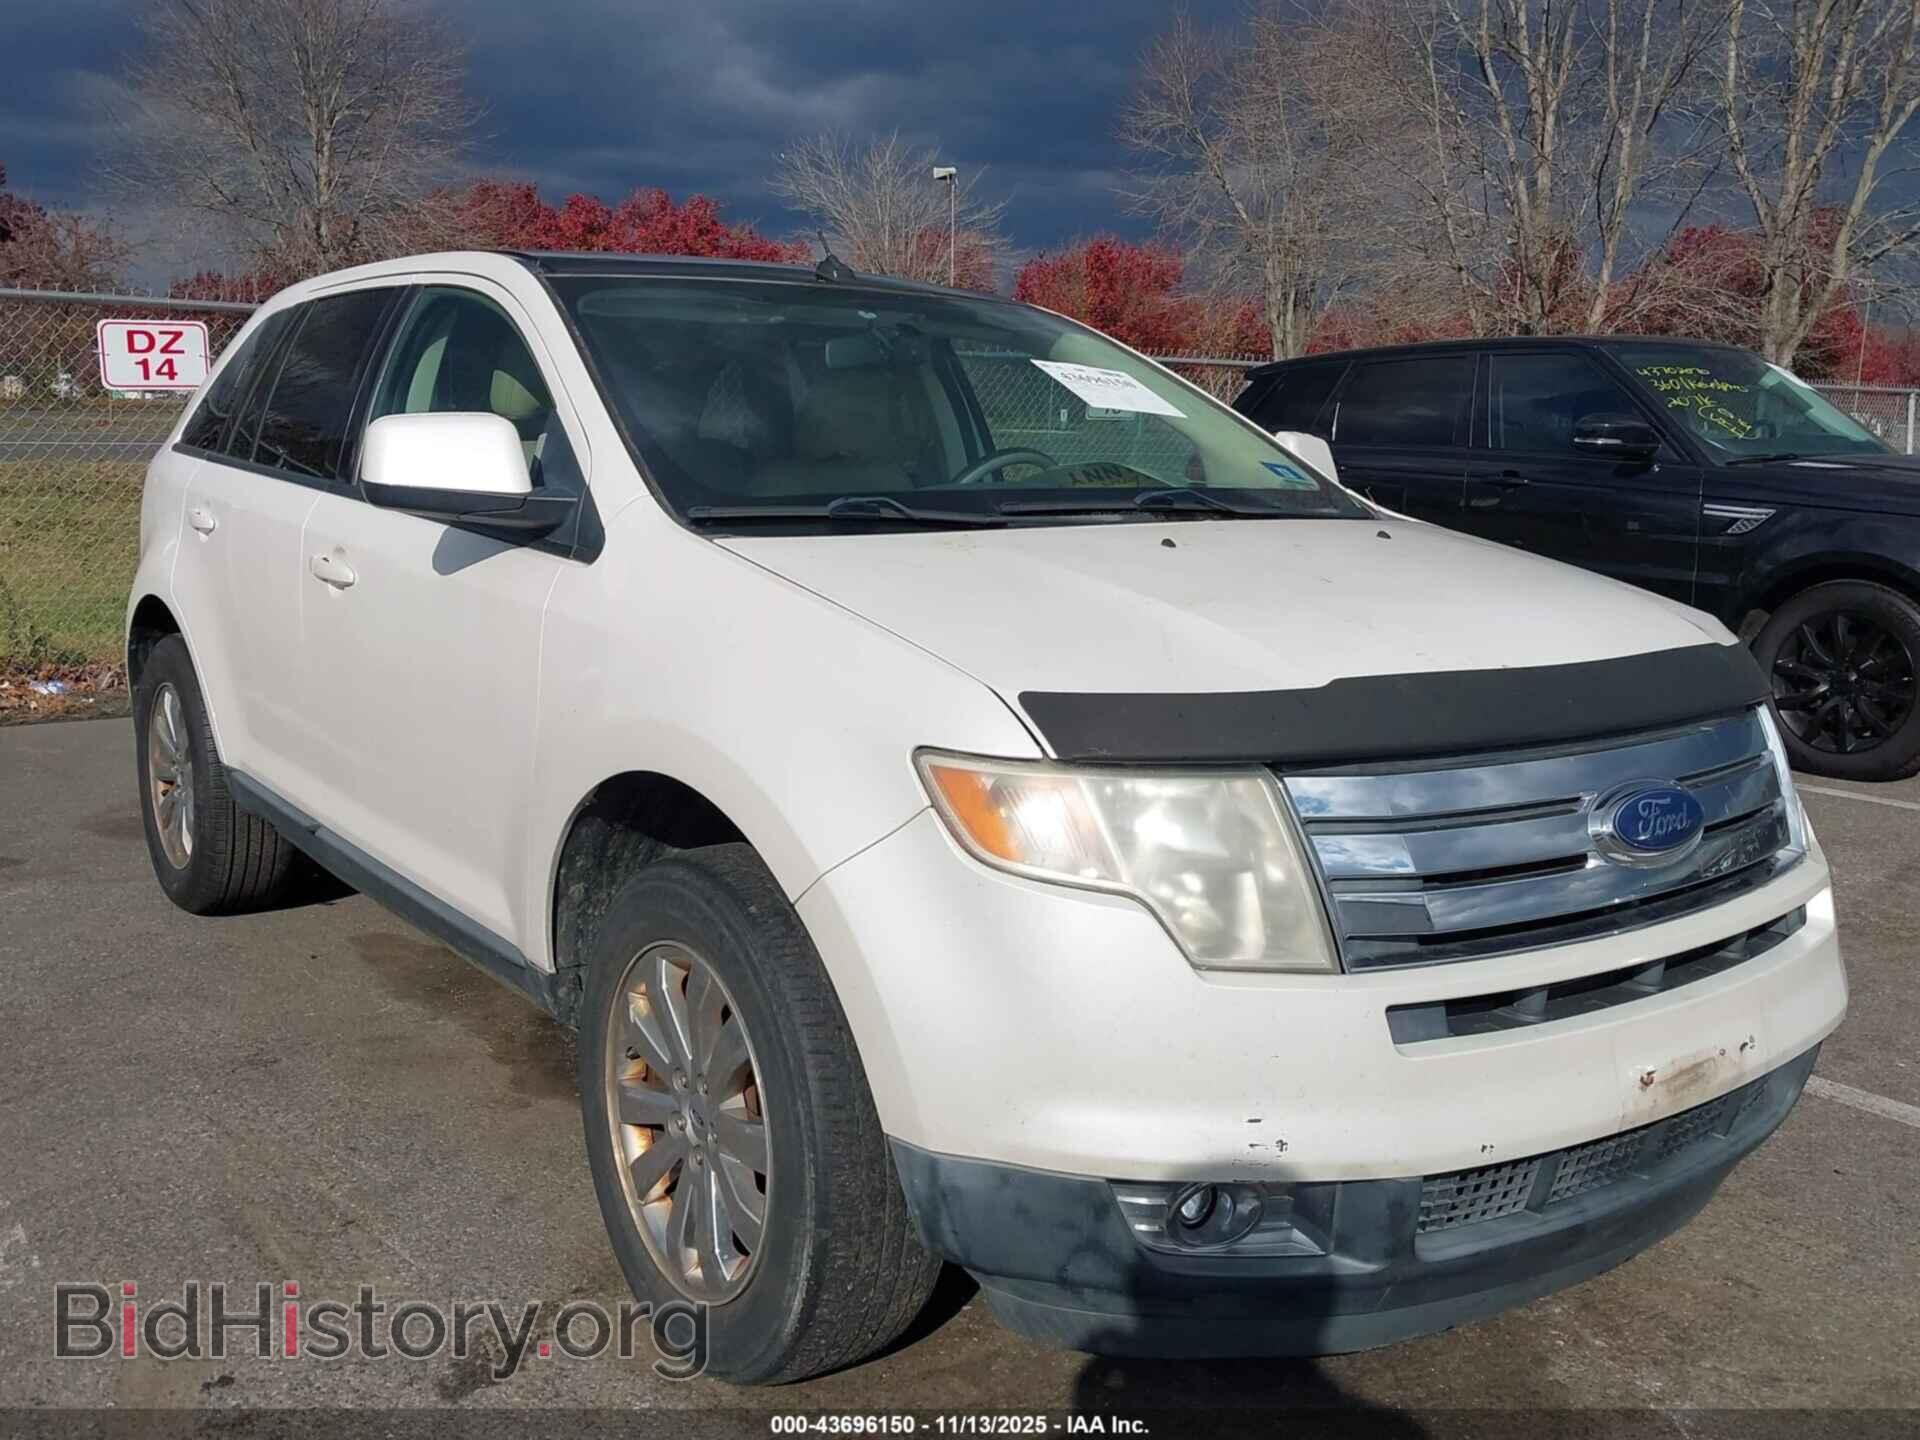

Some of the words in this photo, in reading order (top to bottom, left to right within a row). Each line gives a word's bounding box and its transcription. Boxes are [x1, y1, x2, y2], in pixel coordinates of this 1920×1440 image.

[126, 329, 185, 355] DZ
[134, 357, 179, 381] 14
[1635, 797, 1690, 841] Ford
